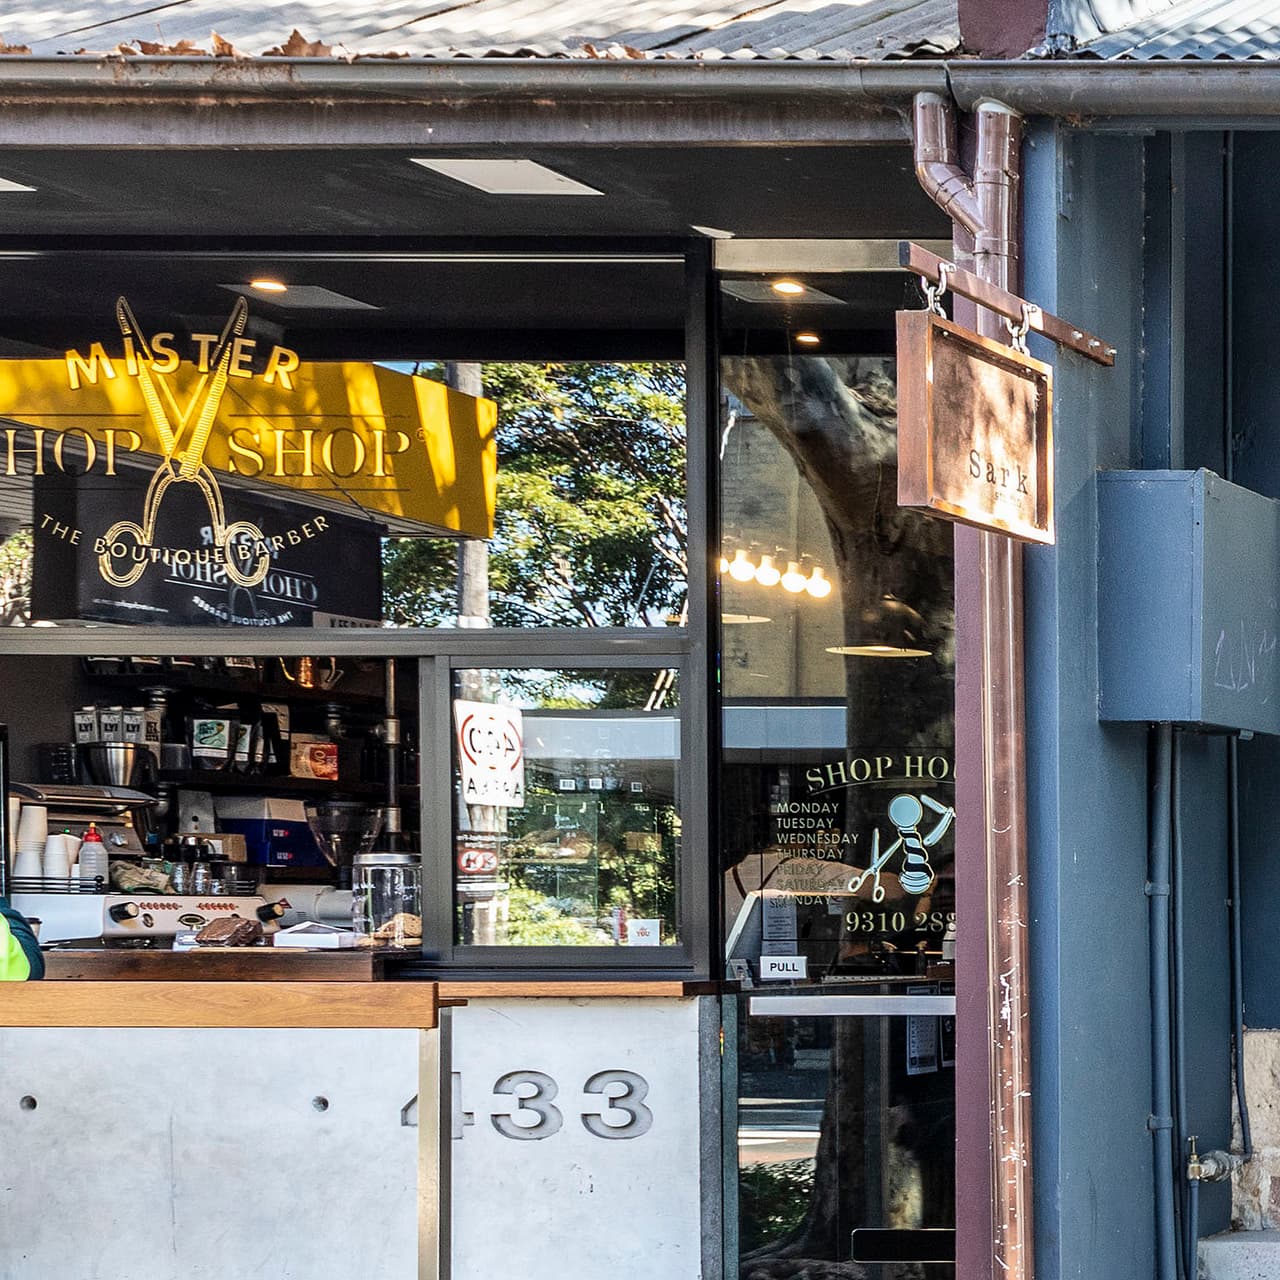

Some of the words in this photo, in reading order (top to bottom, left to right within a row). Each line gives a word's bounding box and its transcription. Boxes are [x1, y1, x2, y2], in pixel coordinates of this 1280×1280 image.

[64, 332, 301, 391] MISTER
[227, 427, 411, 477] SHOP
[969, 449, 1028, 495] Sark
[41, 514, 84, 547] THE
[94, 539, 225, 566] BOUTIQUE
[238, 514, 331, 561] BARBER
[805, 756, 893, 792] SHOP
[904, 755, 956, 780] HO
[777, 803, 839, 814] MONDAY
[776, 818, 834, 829] TUESDAY
[776, 833, 860, 844] WEDNESDAY
[776, 848, 845, 860] THURSDAY
[846, 911, 906, 933] 9310
[769, 963, 799, 972] PULL
[400, 1070, 653, 1140] 433
